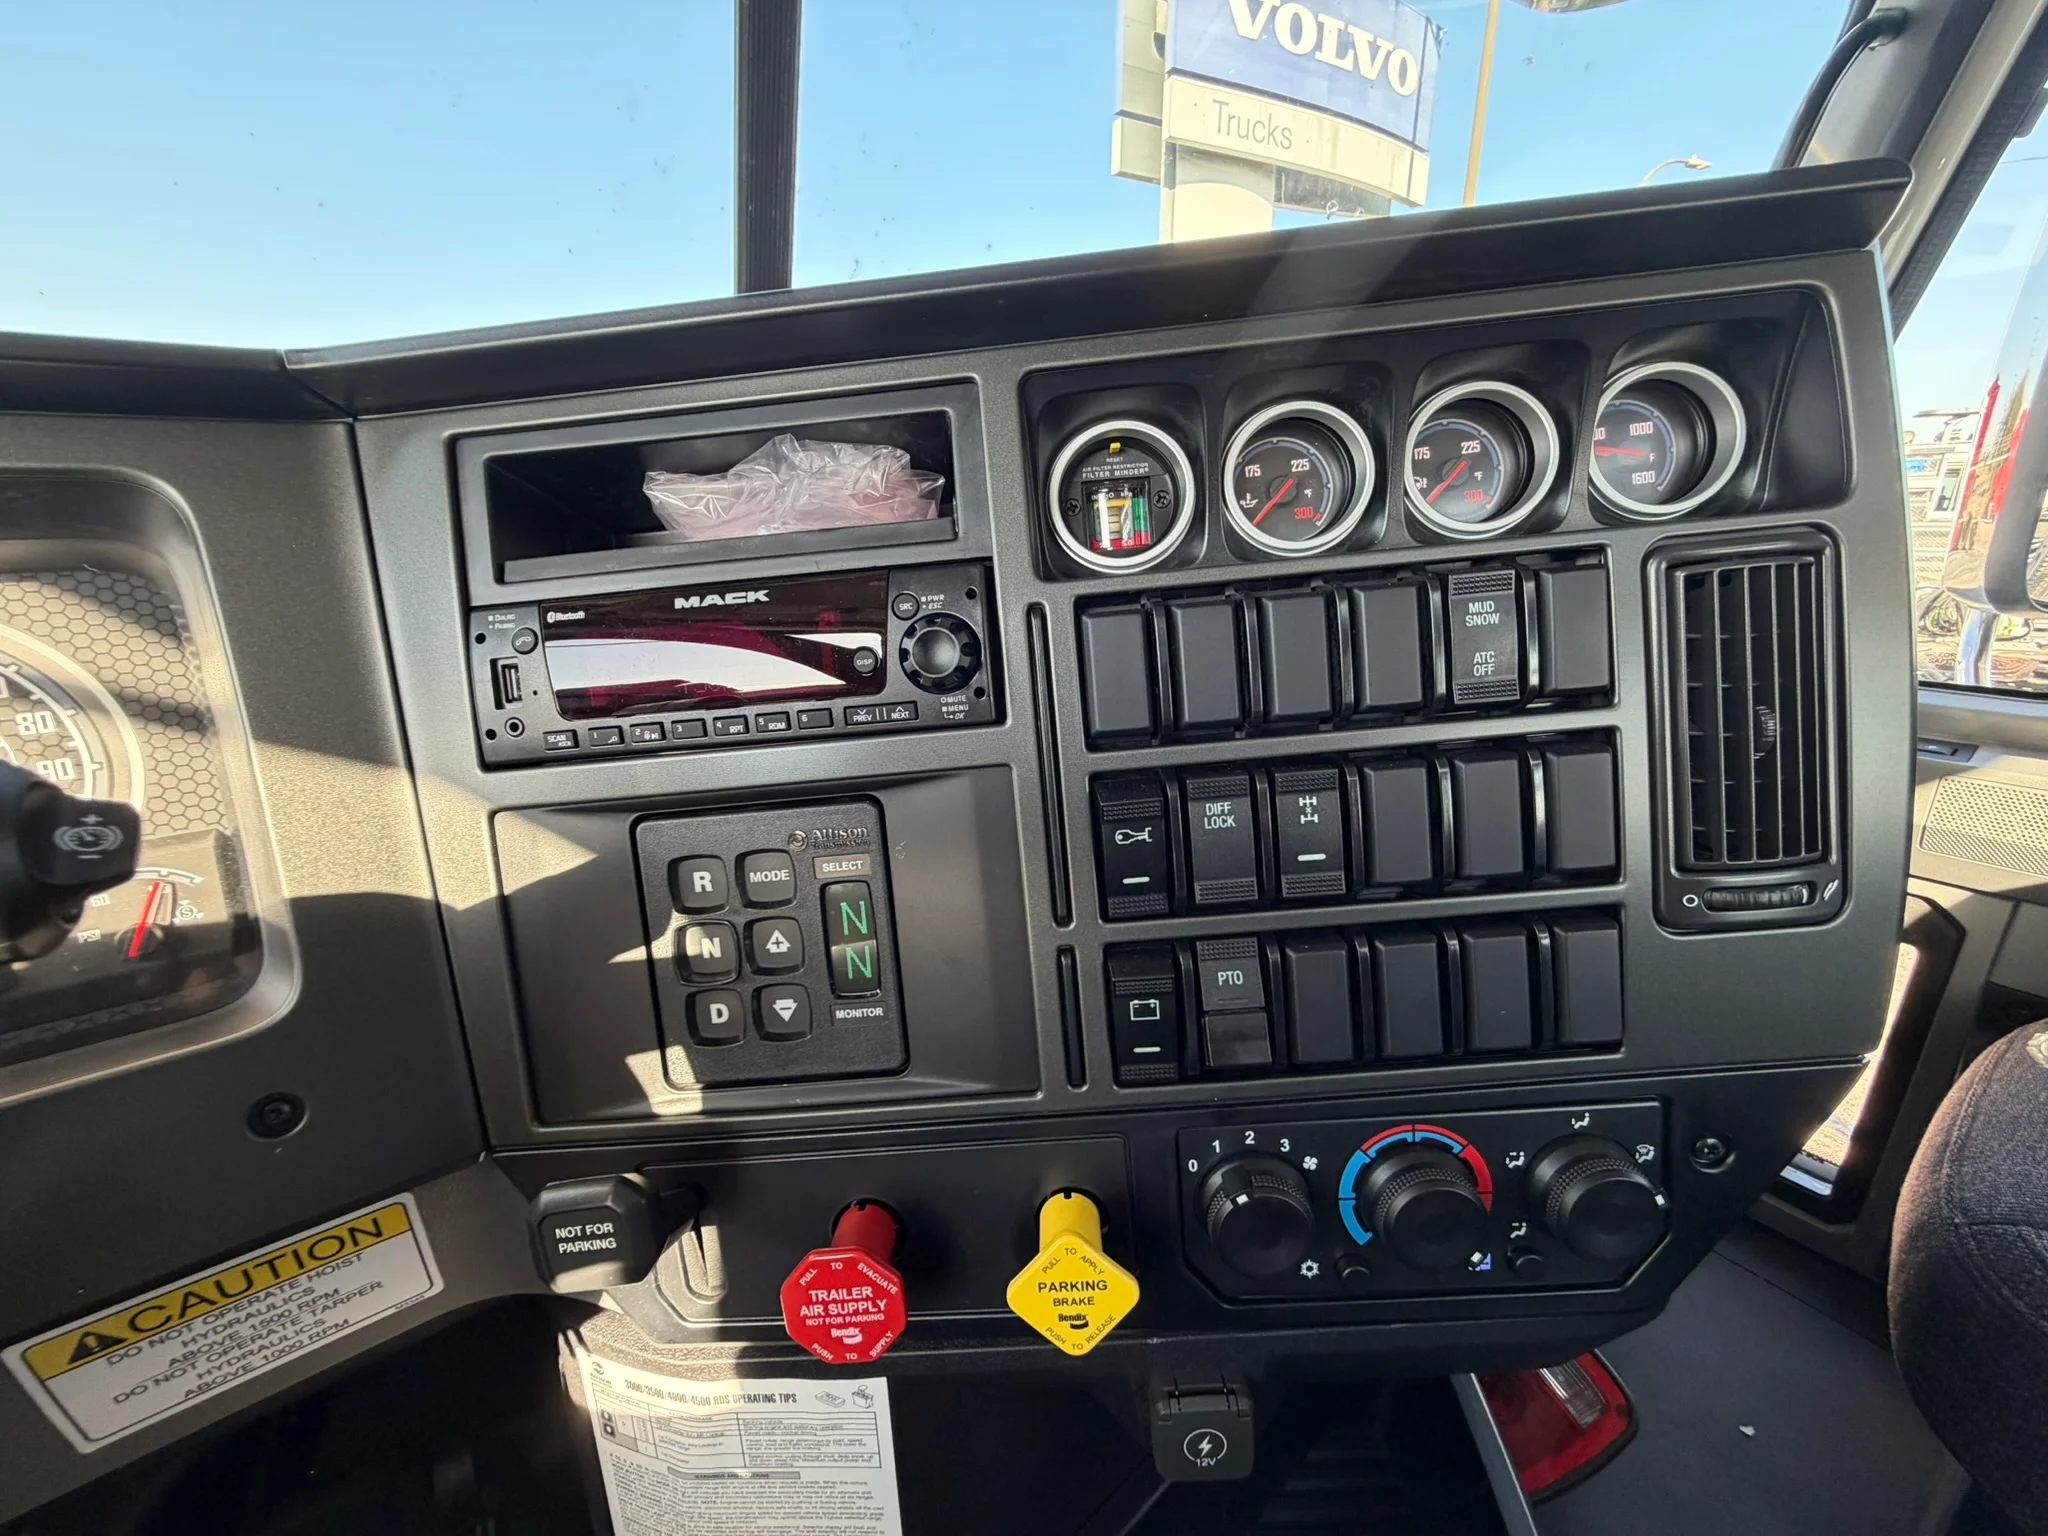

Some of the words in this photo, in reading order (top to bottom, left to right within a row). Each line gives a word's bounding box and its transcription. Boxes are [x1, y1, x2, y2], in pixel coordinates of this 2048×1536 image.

[1227, 0, 1419, 96] VOLVO
[1212, 99, 1293, 150] Trucks
[1629, 421, 1654, 436] 1000
[1460, 440, 1481, 454] 225
[1093, 464, 1112, 472] FILTER
[1112, 462, 1149, 470] RESTRICTION
[1244, 464, 1261, 478] 175
[1290, 458, 1310, 472] 225
[1082, 471, 1110, 479] FILTER
[1632, 470, 1656, 485] 1600
[1464, 489, 1484, 503] 300
[1294, 506, 1314, 520] 300
[674, 589, 770, 609] MACK
[927, 594, 945, 602] PWR
[899, 602, 914, 611] SRC
[928, 602, 943, 610] ESC
[1468, 600, 1495, 614] MUD
[555, 611, 586, 620] Bluetooth
[1465, 612, 1500, 626] SNOW
[856, 658, 873, 666] DISP
[1473, 651, 1495, 664] ATC
[1473, 664, 1496, 676] OFF
[946, 694, 967, 703] MUTE
[890, 710, 910, 719] NEXT
[947, 704, 969, 712] MENU
[15, 709, 57, 736] 80
[801, 714, 808, 722] 6
[852, 712, 873, 722] PREV
[954, 712, 966, 720] OK
[634, 728, 641, 736] 2
[729, 724, 744, 733] RPT
[768, 720, 786, 730] RDM
[546, 734, 566, 742] SCAN
[36, 757, 76, 782] 90
[1205, 802, 1232, 816] DIFF
[1204, 814, 1236, 830] LOCK
[812, 827, 868, 841] Allison
[811, 840, 870, 850] Transmission
[822, 860, 863, 872] SELECT
[692, 870, 714, 893] R
[750, 868, 790, 883] MODE
[840, 900, 868, 936] N
[76, 928, 102, 944] PSI
[700, 936, 722, 959] N
[846, 946, 872, 980] N
[1218, 970, 1244, 986] PTO
[710, 1002, 730, 1024] D
[835, 1007, 884, 1020] MONITOR
[1244, 1130, 1256, 1145] 2
[1212, 1140, 1221, 1154] 1
[1280, 1138, 1290, 1152] 3
[1188, 1158, 1198, 1173] 0
[554, 1226, 583, 1240] NOT
[585, 1222, 614, 1236] FOR
[558, 1238, 617, 1254] PARKING
[1041, 1256, 1061, 1274] PULL
[1064, 1248, 1078, 1256] TO
[1080, 1255, 1105, 1276] APPLY
[128, 1217, 384, 1333] CAUTION
[799, 1267, 818, 1286] PULL
[830, 1262, 844, 1270] TO
[856, 1262, 900, 1295] EVACUATE
[808, 1286, 874, 1302] TRAILER
[1038, 1280, 1108, 1294] PARKING
[800, 1304, 825, 1317] AIR
[828, 1298, 888, 1314] SUPPLY
[1053, 1296, 1096, 1307] BRAKE
[106, 1345, 142, 1366] DO
[150, 1322, 193, 1349] NOT
[202, 1278, 302, 1325] OPERATE
[306, 1252, 364, 1283] HOIST
[181, 1286, 317, 1349] HYDRAULICS
[806, 1318, 824, 1326] NOT
[825, 1316, 844, 1324] FOR
[846, 1312, 885, 1324] PARKING
[1058, 1313, 1088, 1322] Bendix
[168, 1330, 243, 1368] ABOVE
[249, 1308, 293, 1332] 1500
[297, 1288, 341, 1312] RPM
[830, 1326, 861, 1338] Bendix
[1044, 1326, 1067, 1345] PUSH
[1071, 1342, 1084, 1351] TO
[1084, 1314, 1116, 1344] RELEASE
[113, 1384, 148, 1405] DO
[153, 1362, 196, 1387] NOT
[205, 1315, 307, 1364] OPERATE
[310, 1280, 384, 1318] TARPER
[196, 1318, 326, 1380] HYDRAULICS
[812, 1343, 834, 1361] PUSH
[845, 1352, 858, 1360] TO
[868, 1330, 894, 1358] SUPPLY
[184, 1363, 256, 1399] ABOVE
[261, 1339, 304, 1364] 1000
[308, 1318, 350, 1342] RPM
[713, 1394, 730, 1406] RDS
[732, 1392, 776, 1404] OPERATING
[778, 1392, 798, 1404] TIPS
[1196, 1456, 1217, 1468] 12V
